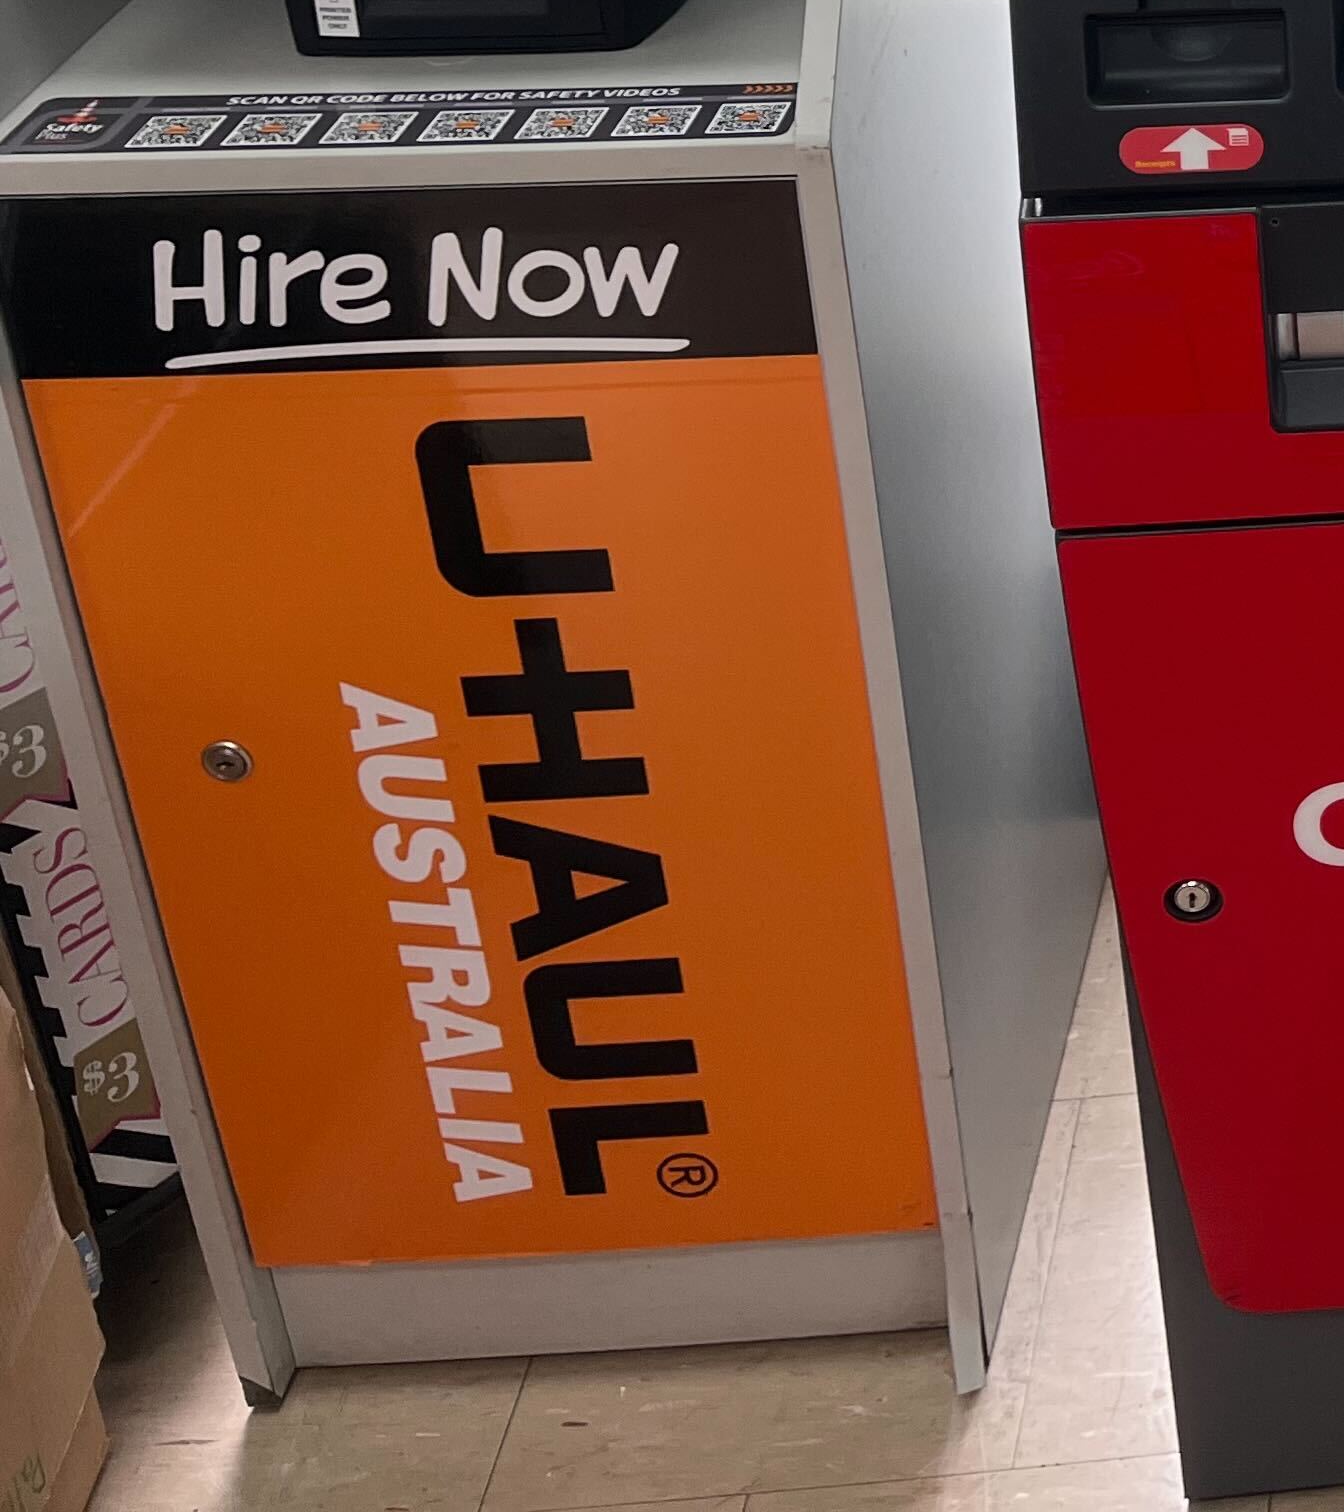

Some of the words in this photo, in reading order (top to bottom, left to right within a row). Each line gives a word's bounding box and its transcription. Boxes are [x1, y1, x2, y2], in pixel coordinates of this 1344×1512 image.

[43, 121, 104, 136] Safety
[226, 94, 286, 107] SCAN
[290, 94, 322, 105] QR
[326, 92, 389, 105] CODE
[392, 91, 468, 104] BELOW
[471, 90, 514, 102] FOR
[516, 89, 600, 101] SAFETY
[602, 87, 681, 99] VIDEOS
[152, 229, 391, 332] Hire
[428, 226, 680, 328] Now
[31, 825, 127, 1029] CARDS
[338, 682, 533, 1203] AUSTRALIA
[81, 1049, 141, 1103] $3
